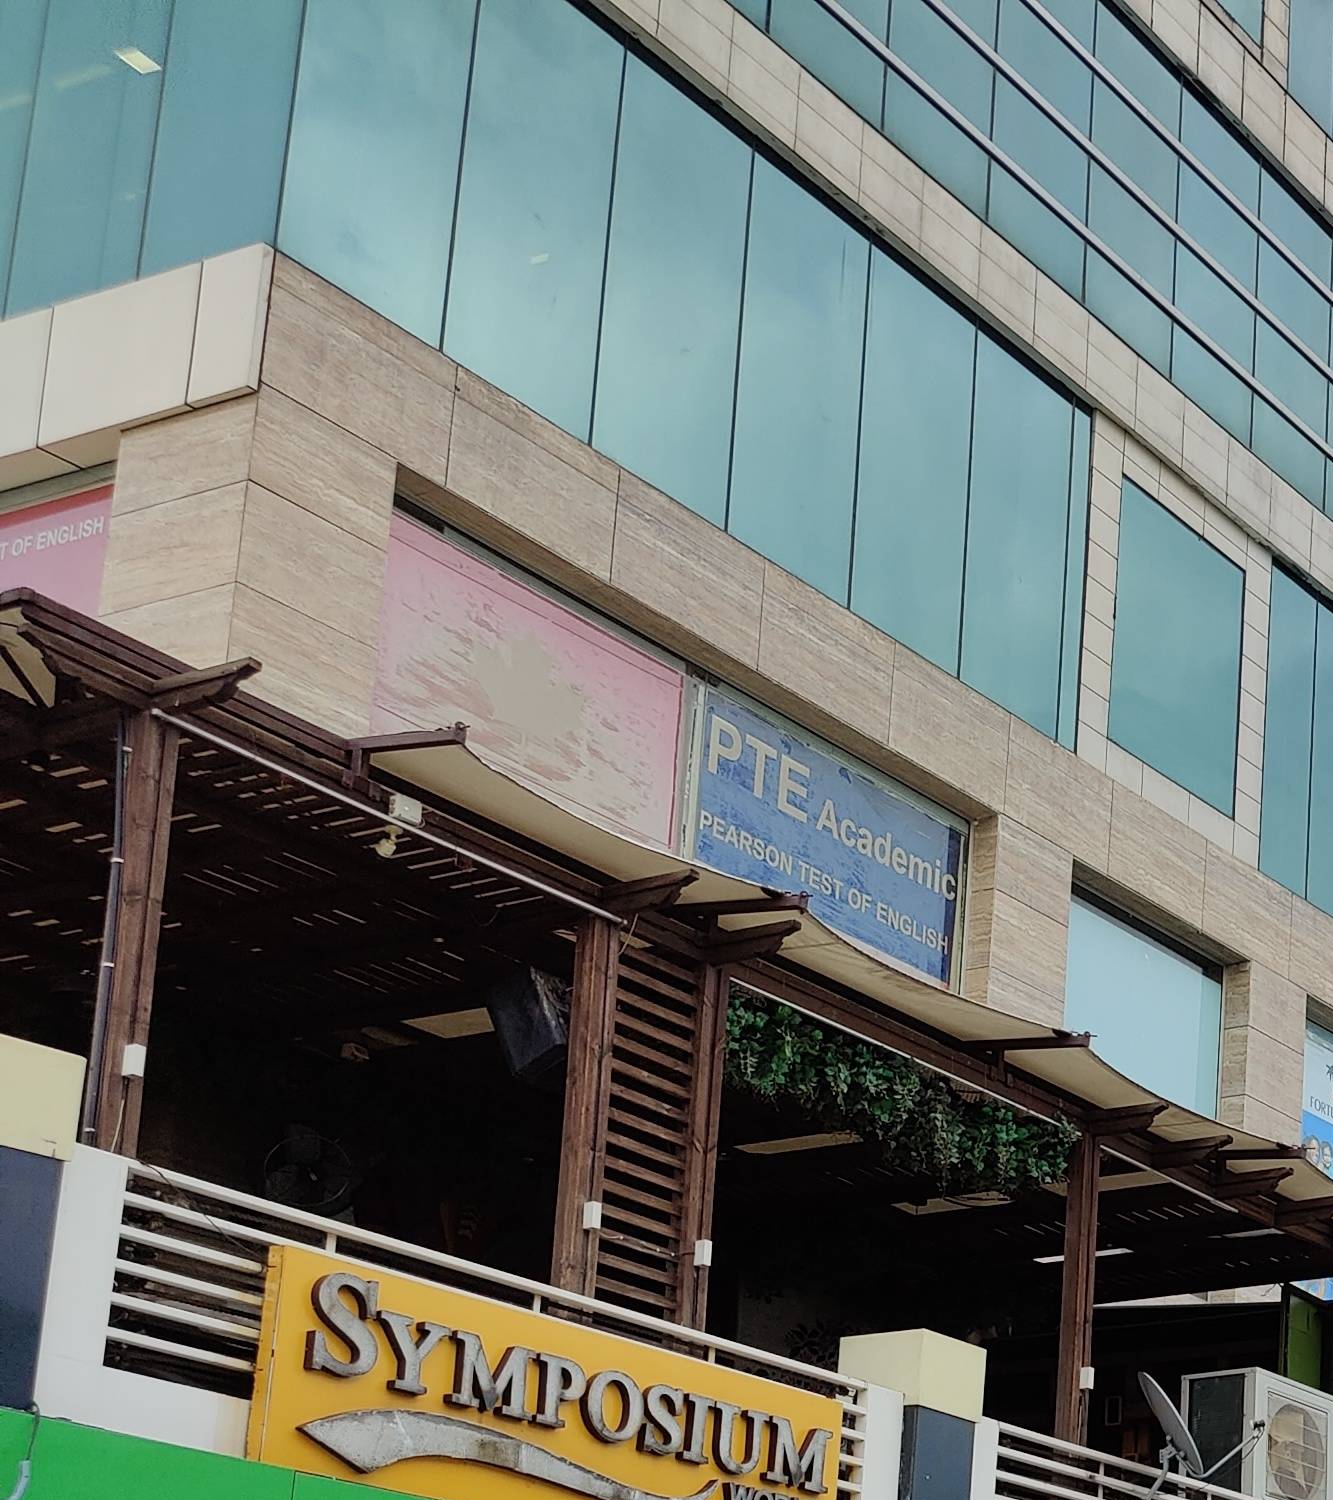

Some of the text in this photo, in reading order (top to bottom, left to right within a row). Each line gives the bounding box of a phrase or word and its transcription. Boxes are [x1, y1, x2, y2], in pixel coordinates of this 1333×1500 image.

[12, 535, 34, 556] OF
[36, 517, 104, 550] ENGLISH
[699, 809, 949, 953] PEARSON TEST OF ENGLISH
[707, 714, 958, 901] PTE Academic
[303, 1271, 833, 1495] SYMPOSIUM
